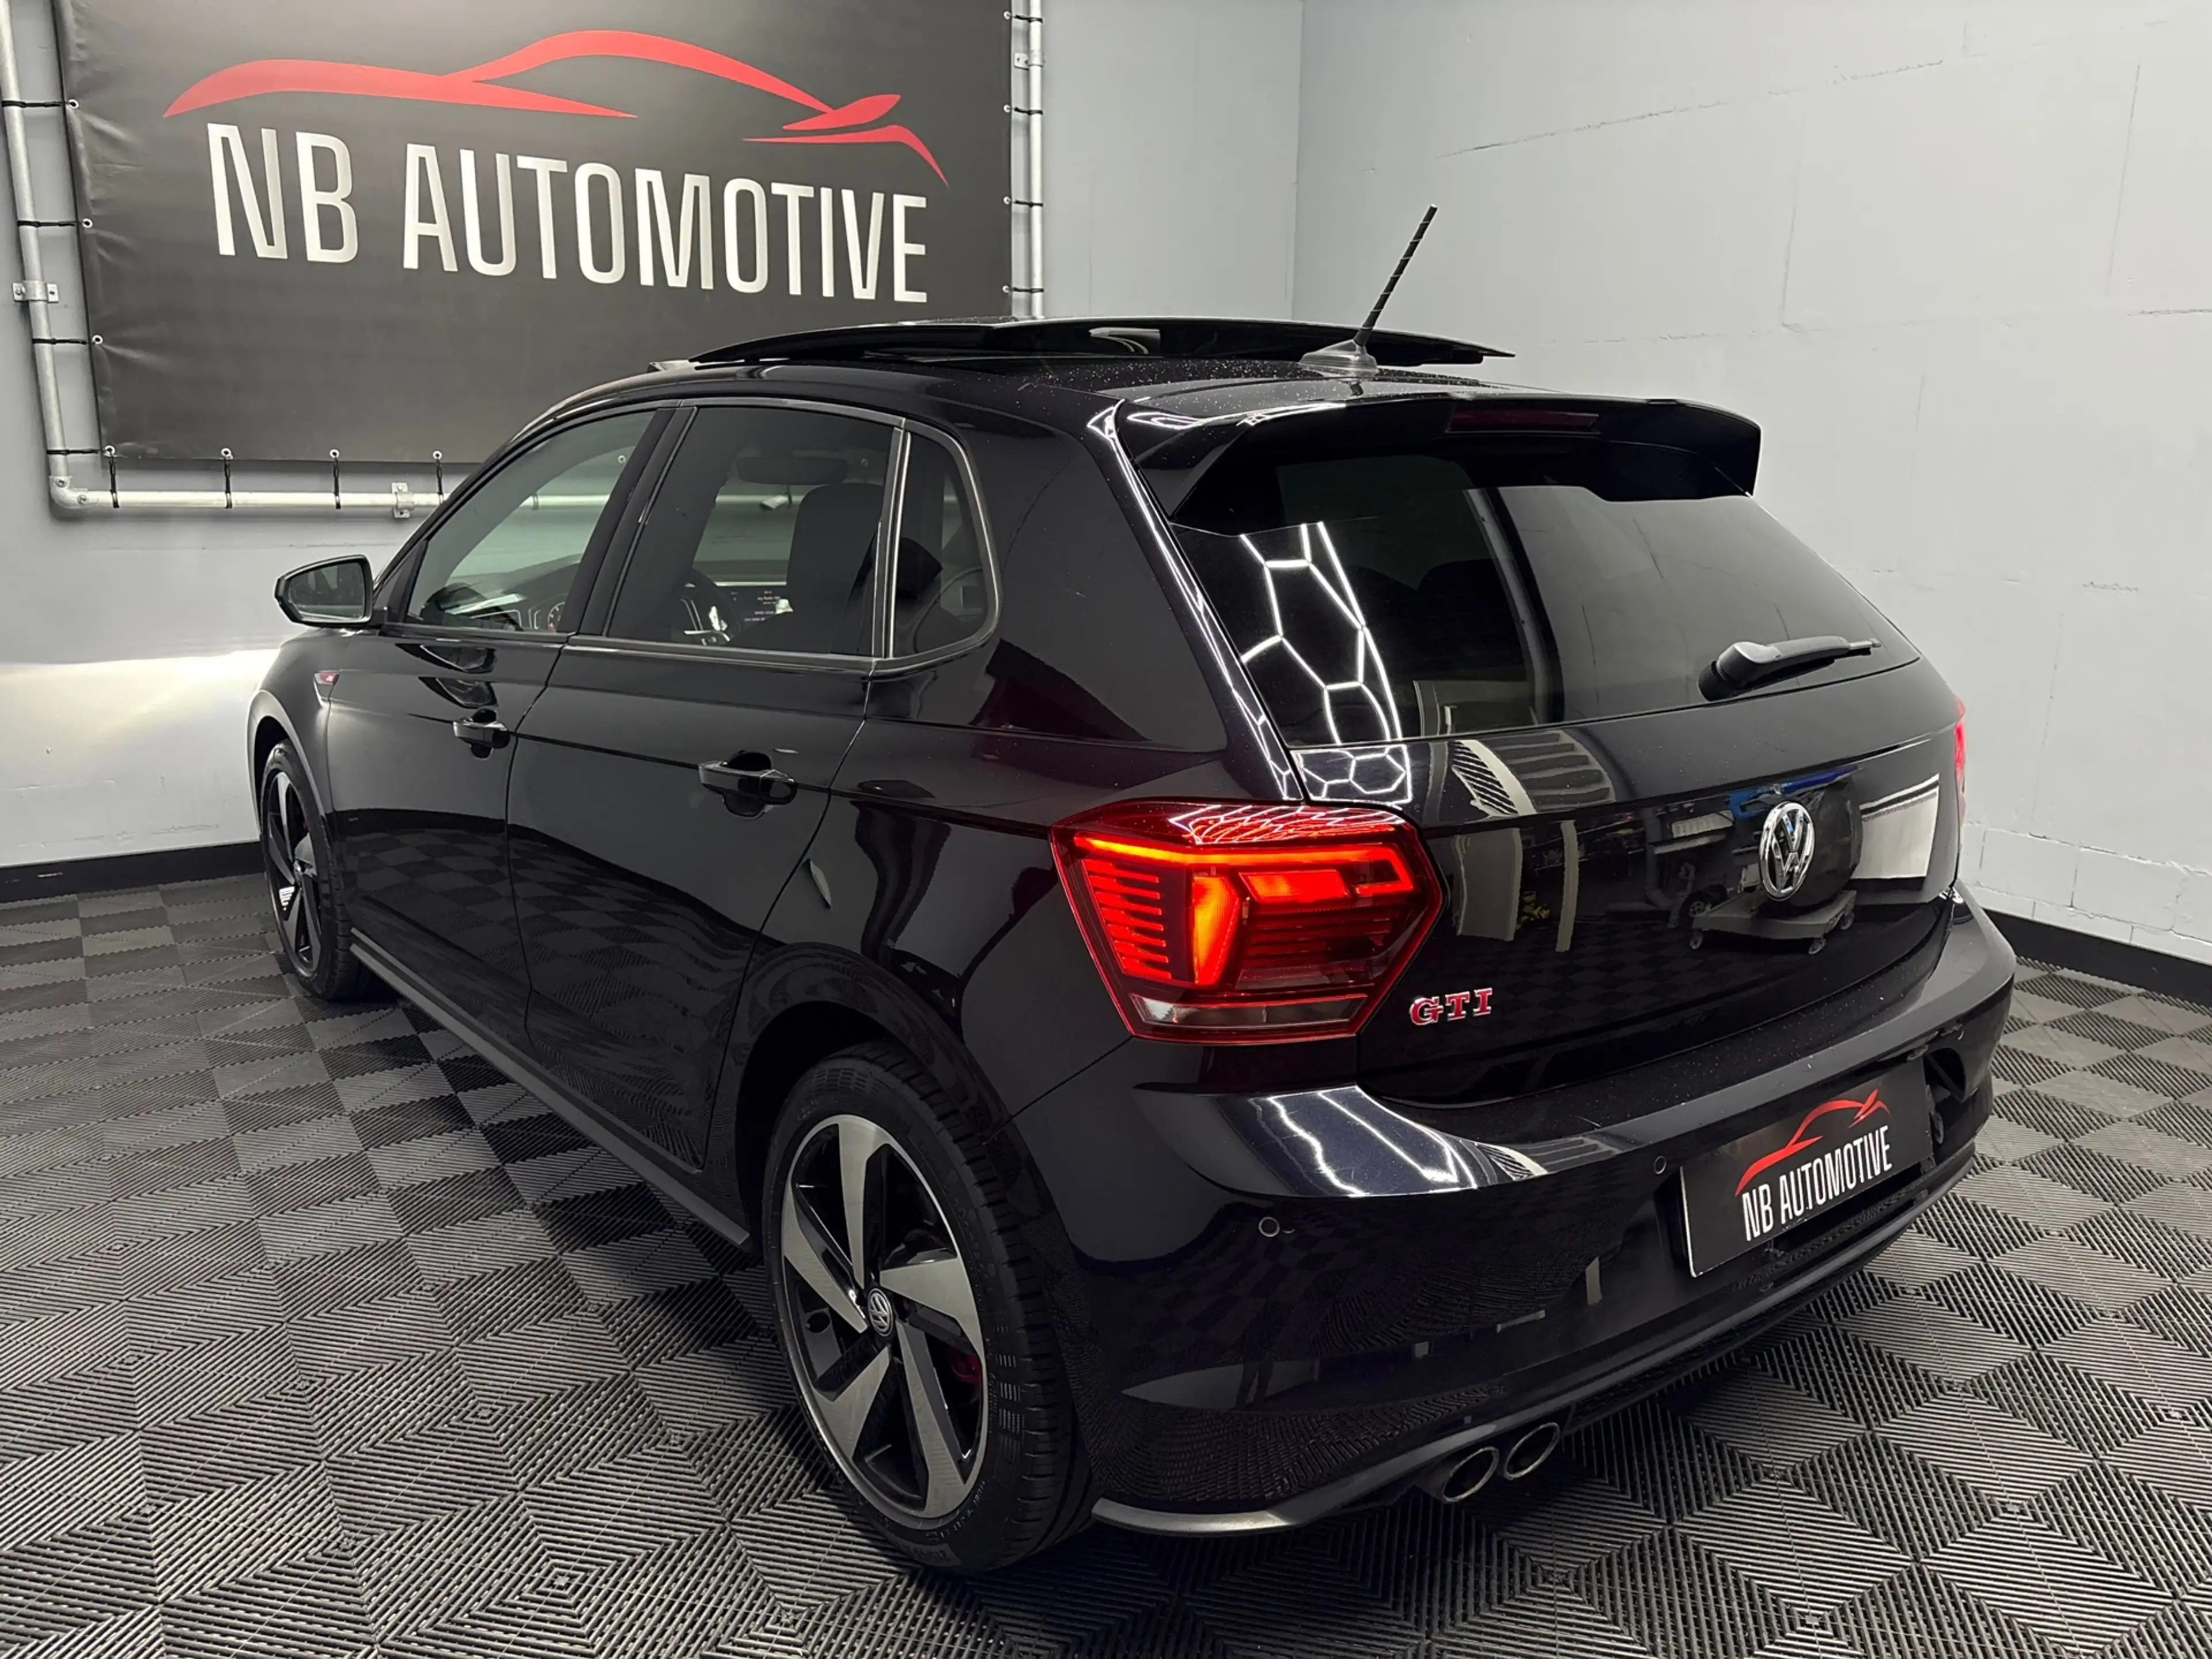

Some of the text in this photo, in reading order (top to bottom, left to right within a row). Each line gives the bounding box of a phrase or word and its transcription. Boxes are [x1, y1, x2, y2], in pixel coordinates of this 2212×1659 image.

[207, 122, 927, 303] NB AUTOMOTIVE
[1409, 987, 1493, 1026] GTI
[1741, 1125, 1893, 1242] NB AUTOMOTIVE
